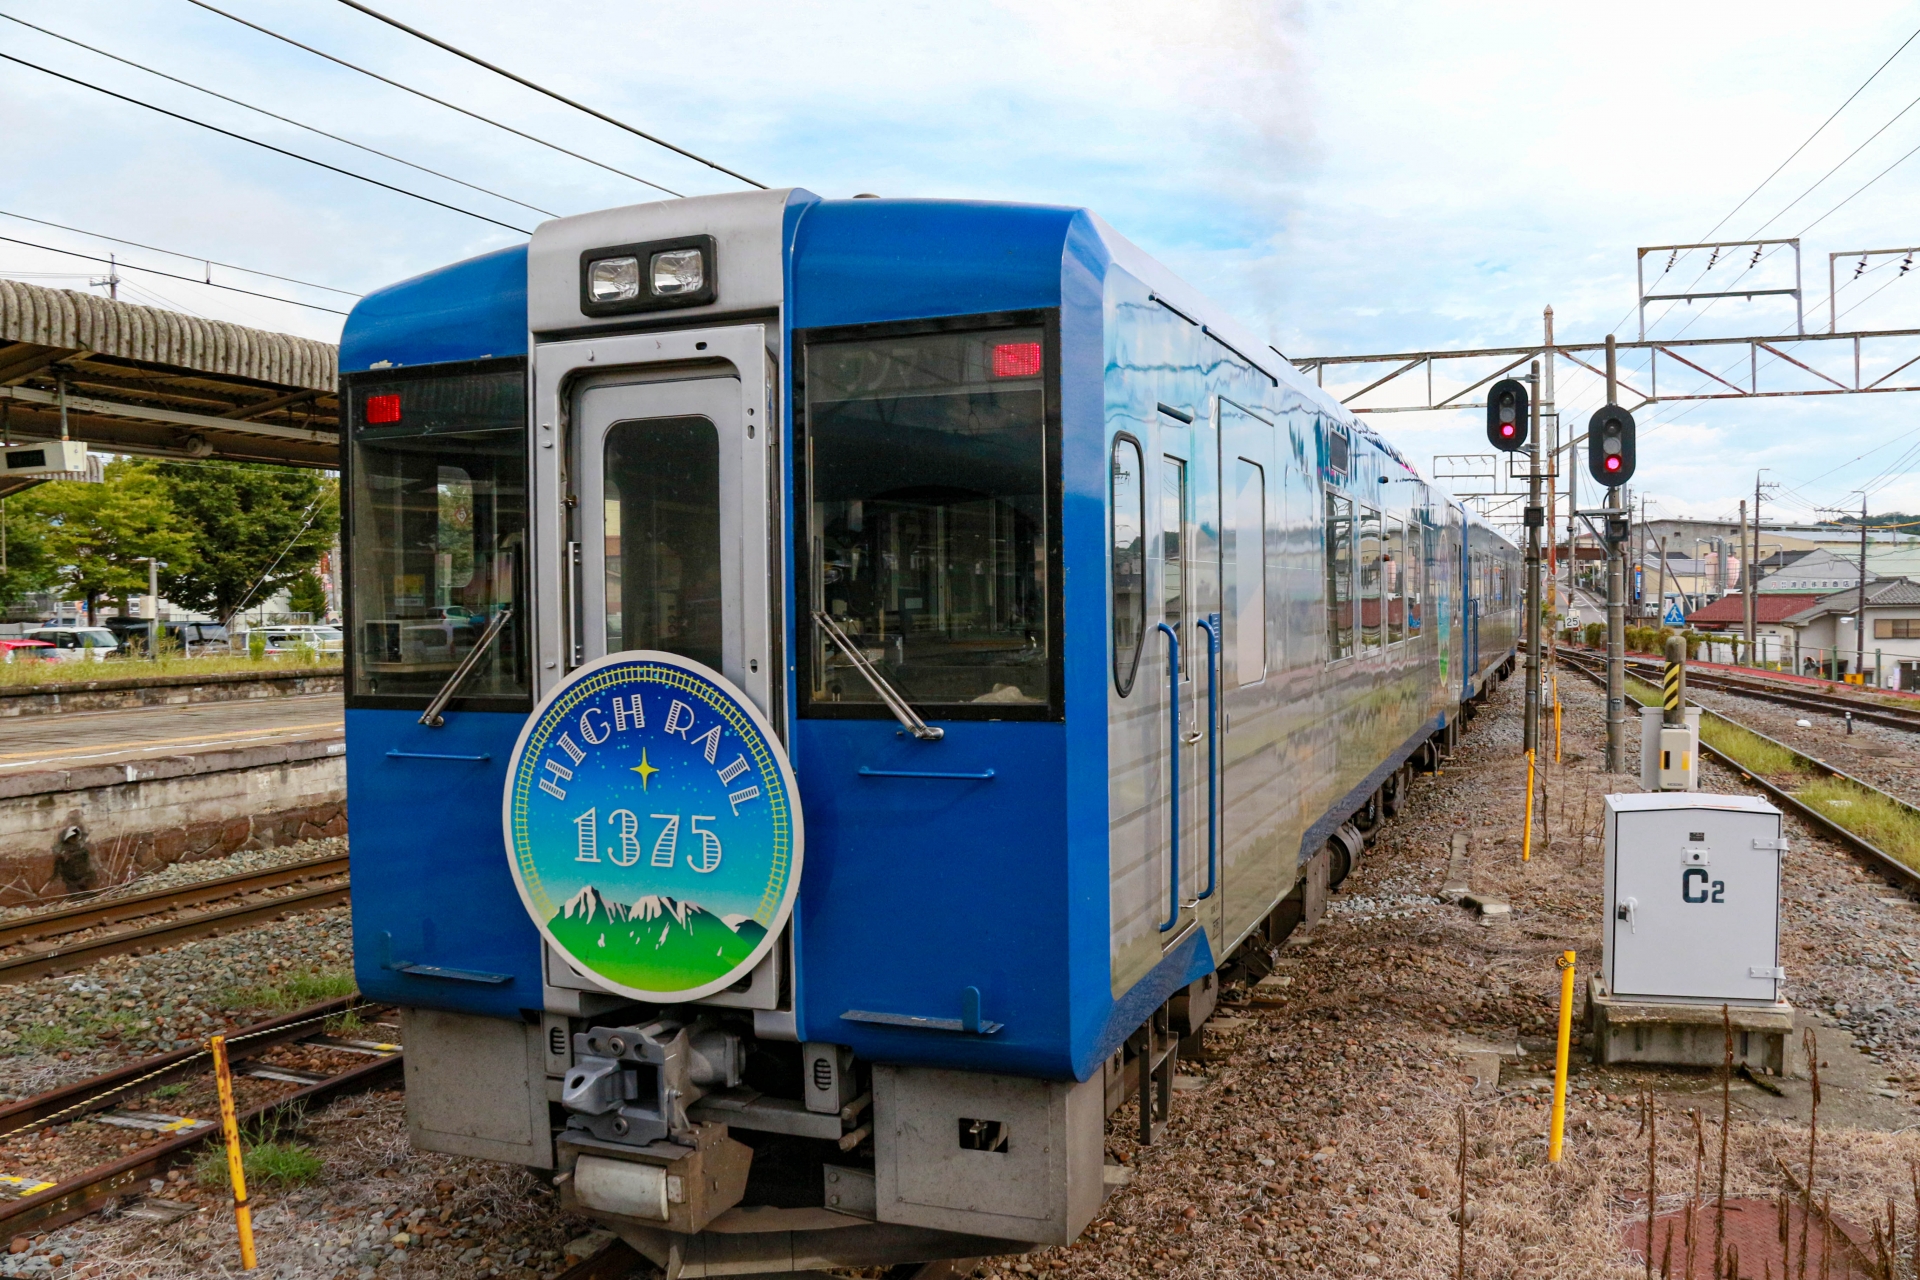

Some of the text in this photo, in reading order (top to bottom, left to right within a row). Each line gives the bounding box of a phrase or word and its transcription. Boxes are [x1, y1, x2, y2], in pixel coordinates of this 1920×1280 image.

[1566, 617, 1579, 627] 25
[538, 694, 760, 816] HIGH RAIL
[573, 807, 722, 873] 1375
[1682, 868, 1725, 904] C2
